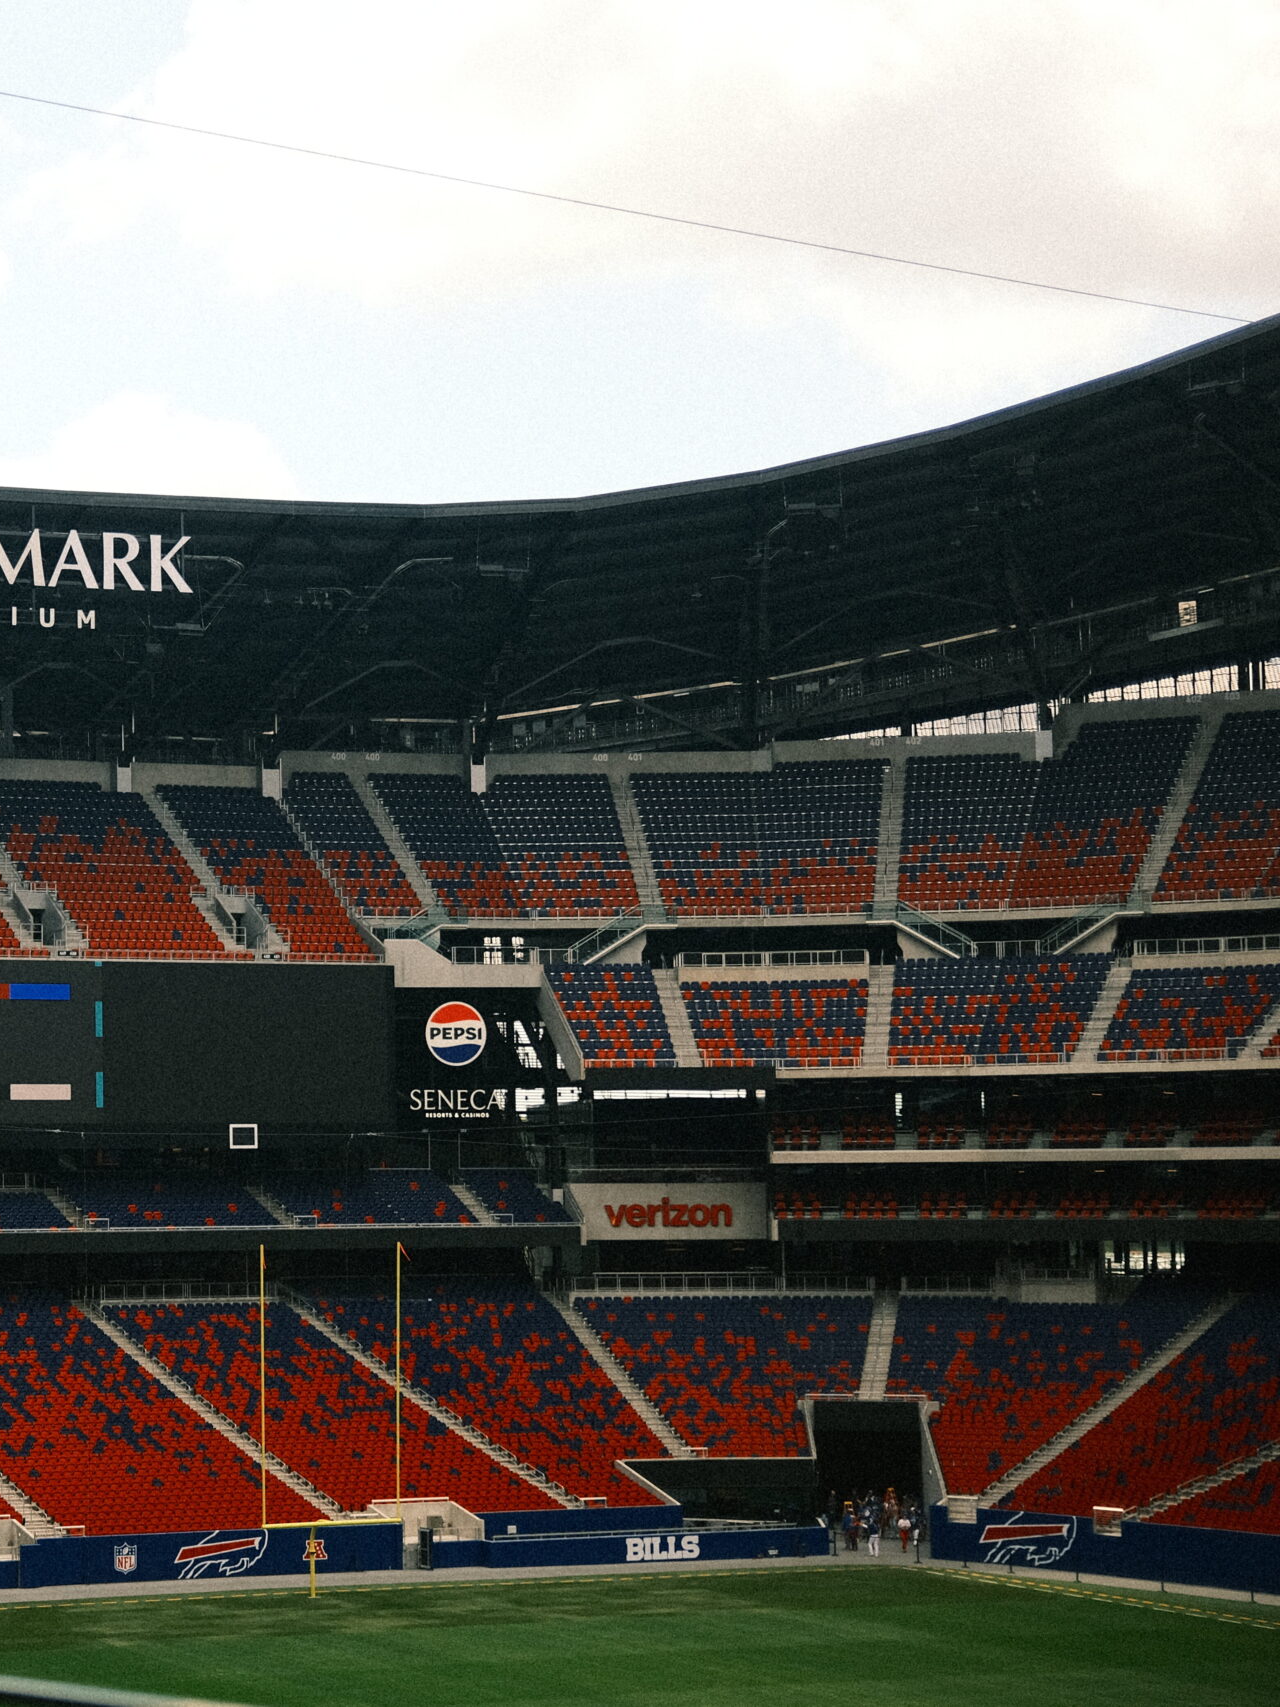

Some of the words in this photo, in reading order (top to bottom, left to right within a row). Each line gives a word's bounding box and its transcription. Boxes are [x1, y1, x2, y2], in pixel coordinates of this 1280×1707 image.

[331, 752, 346, 761] 400
[365, 752, 380, 761] 400
[592, 753, 608, 762] 400
[627, 753, 642, 761] 401
[429, 1027, 483, 1041] PEPSI
[409, 1089, 503, 1111] SENECA
[604, 1196, 733, 1228] verizon
[625, 1535, 701, 1562] BILLS
[117, 1555, 134, 1570] NFL
